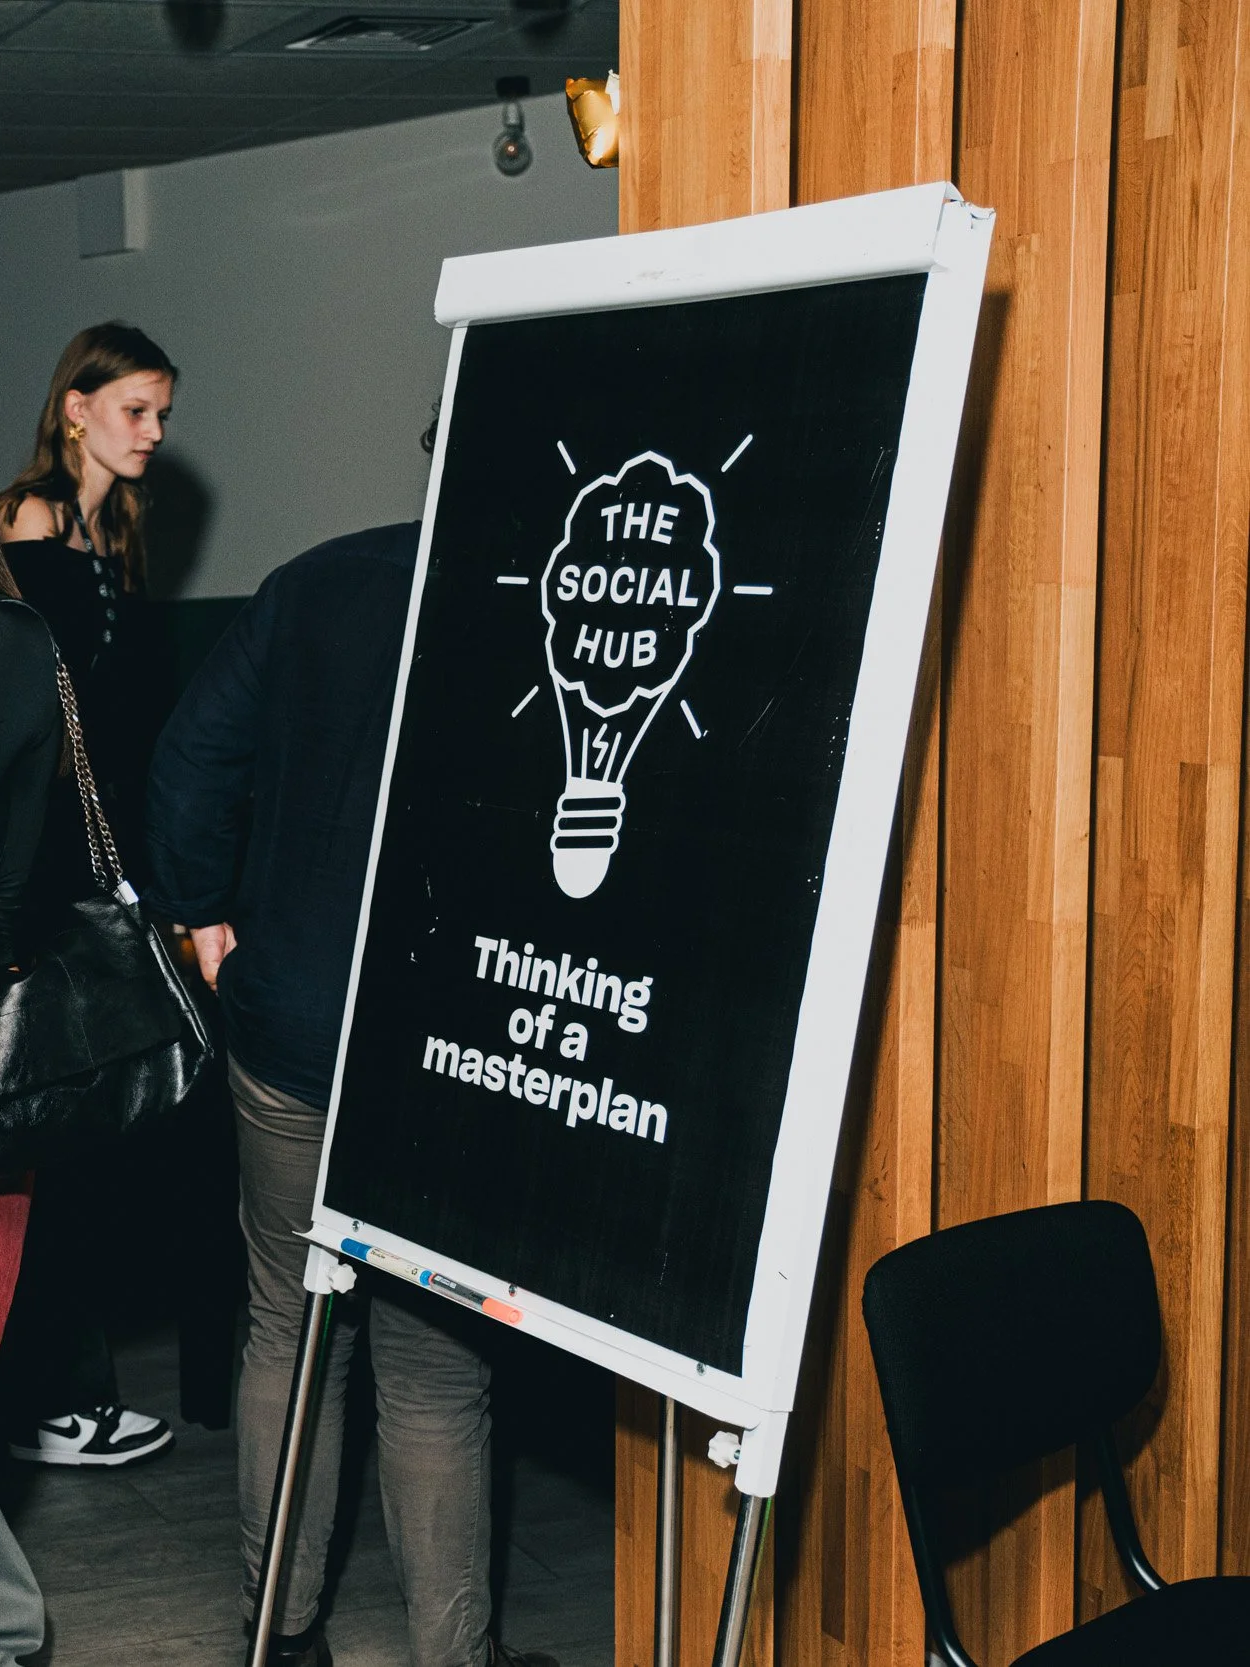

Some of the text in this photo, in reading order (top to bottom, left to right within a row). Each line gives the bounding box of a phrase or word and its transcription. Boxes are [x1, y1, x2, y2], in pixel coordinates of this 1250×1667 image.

[600, 502, 680, 545] THE
[556, 564, 699, 607] SOCIAL
[573, 623, 657, 668] HUB
[474, 935, 654, 1034] Thinking
[508, 1003, 589, 1062] of a
[422, 1035, 668, 1144] masterplan
